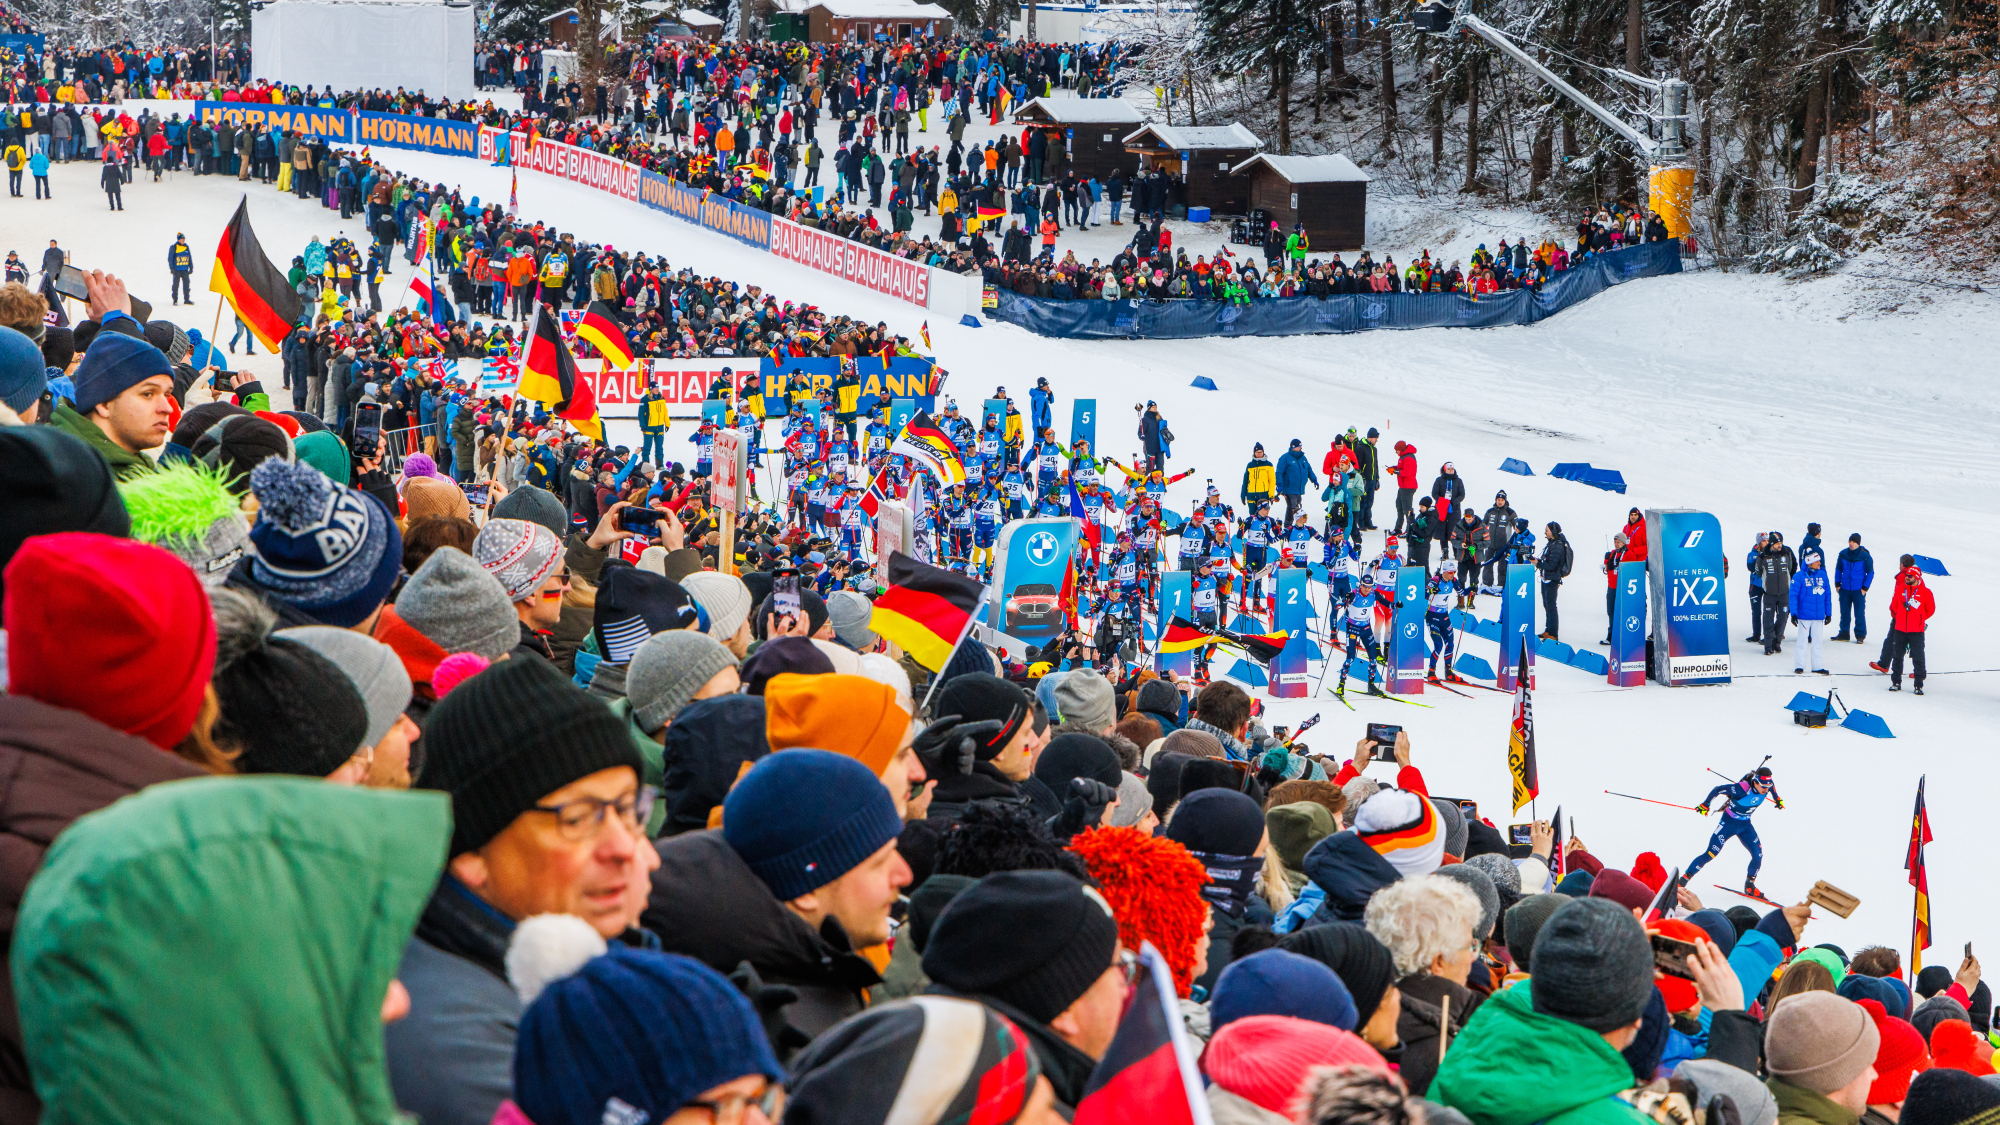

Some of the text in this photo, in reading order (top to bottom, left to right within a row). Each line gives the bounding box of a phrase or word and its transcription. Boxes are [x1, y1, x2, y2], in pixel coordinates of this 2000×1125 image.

[361, 116, 474, 152] HÖRMANN
[481, 130, 567, 179] BUHAUS
[570, 145, 638, 200] BAUHAUS
[641, 175, 699, 220] HÖRMANN
[705, 199, 768, 246] HÖRMANN
[772, 221, 844, 278] BAUHAUS
[846, 244, 927, 301] BAUHAUS
[711, 414, 718, 425] 1
[898, 413, 908, 425] 3
[1081, 411, 1091, 424] 5
[835, 454, 845, 462] 46
[969, 467, 980, 475] 39
[1007, 483, 1018, 492] 35
[983, 502, 994, 510] 26
[1144, 531, 1153, 539] 19
[1188, 540, 1199, 548] 15
[1337, 558, 1346, 567] 12
[1123, 565, 1133, 574] 10
[1389, 571, 1396, 579] 8
[1405, 584, 1418, 601] 3
[1516, 582, 1528, 598] 4
[1627, 579, 1638, 595] 5
[1673, 576, 1718, 607] iX2
[1173, 590, 1182, 606] 1
[1205, 591, 1211, 600] 6
[1287, 588, 1299, 604] 2
[1360, 608, 1367, 616] 3
[1690, 613, 1719, 621] ELECTRIC
[1673, 663, 1728, 674] RUHPOLDING
